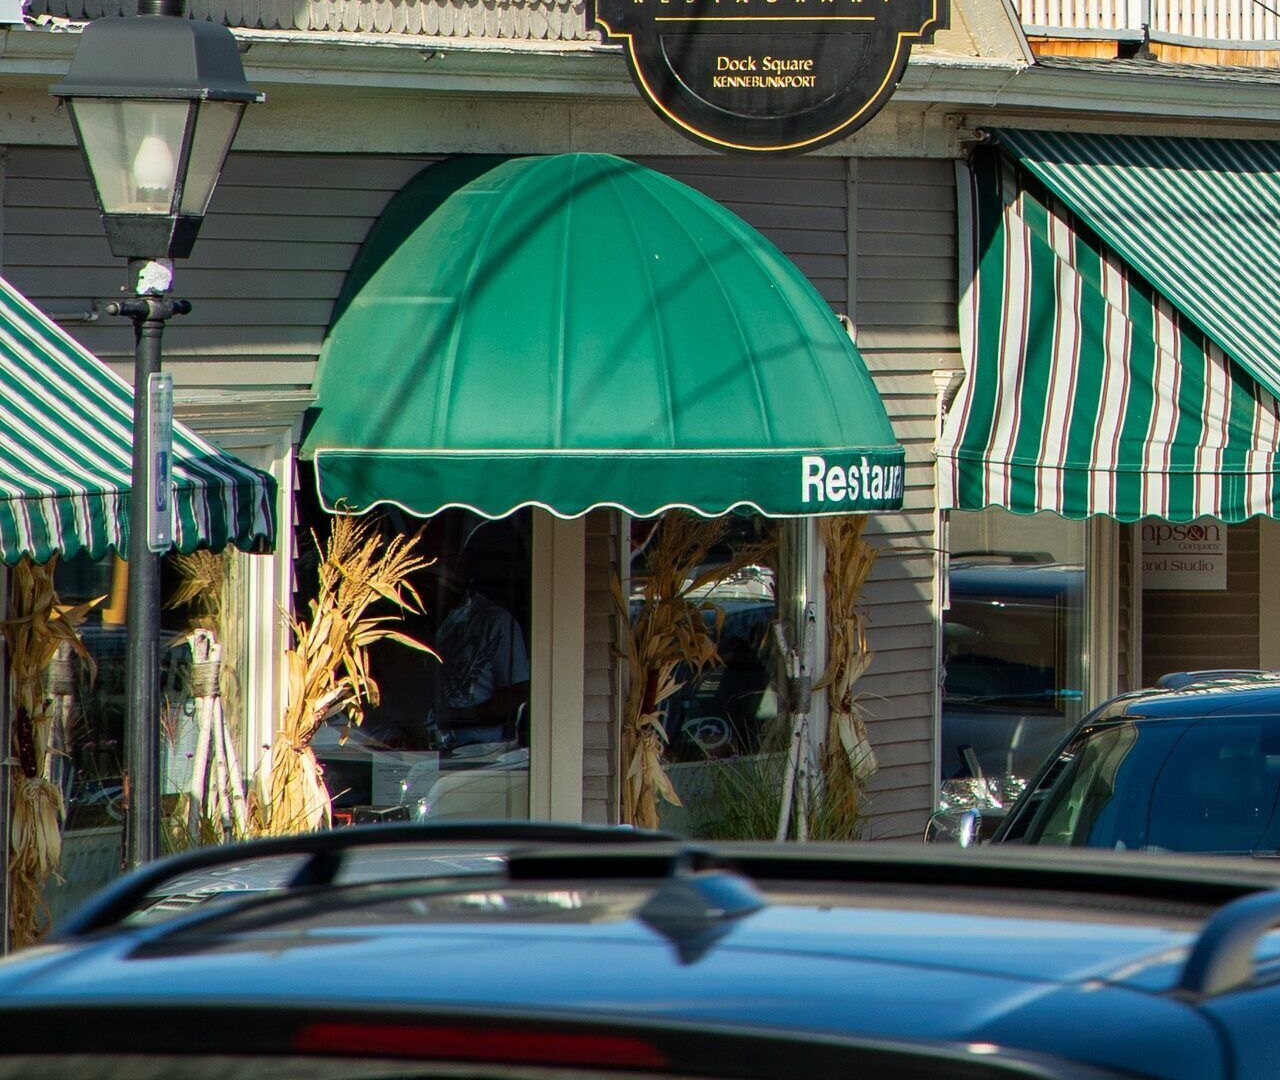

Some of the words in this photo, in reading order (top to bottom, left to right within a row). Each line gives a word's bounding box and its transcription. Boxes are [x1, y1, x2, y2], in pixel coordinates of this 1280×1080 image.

[717, 56, 757, 71] Dock
[761, 56, 813, 75] Square
[712, 75, 816, 89] KENNEBUNKPORT
[1177, 542, 1221, 552] Company
[1170, 560, 1214, 572] Studio
